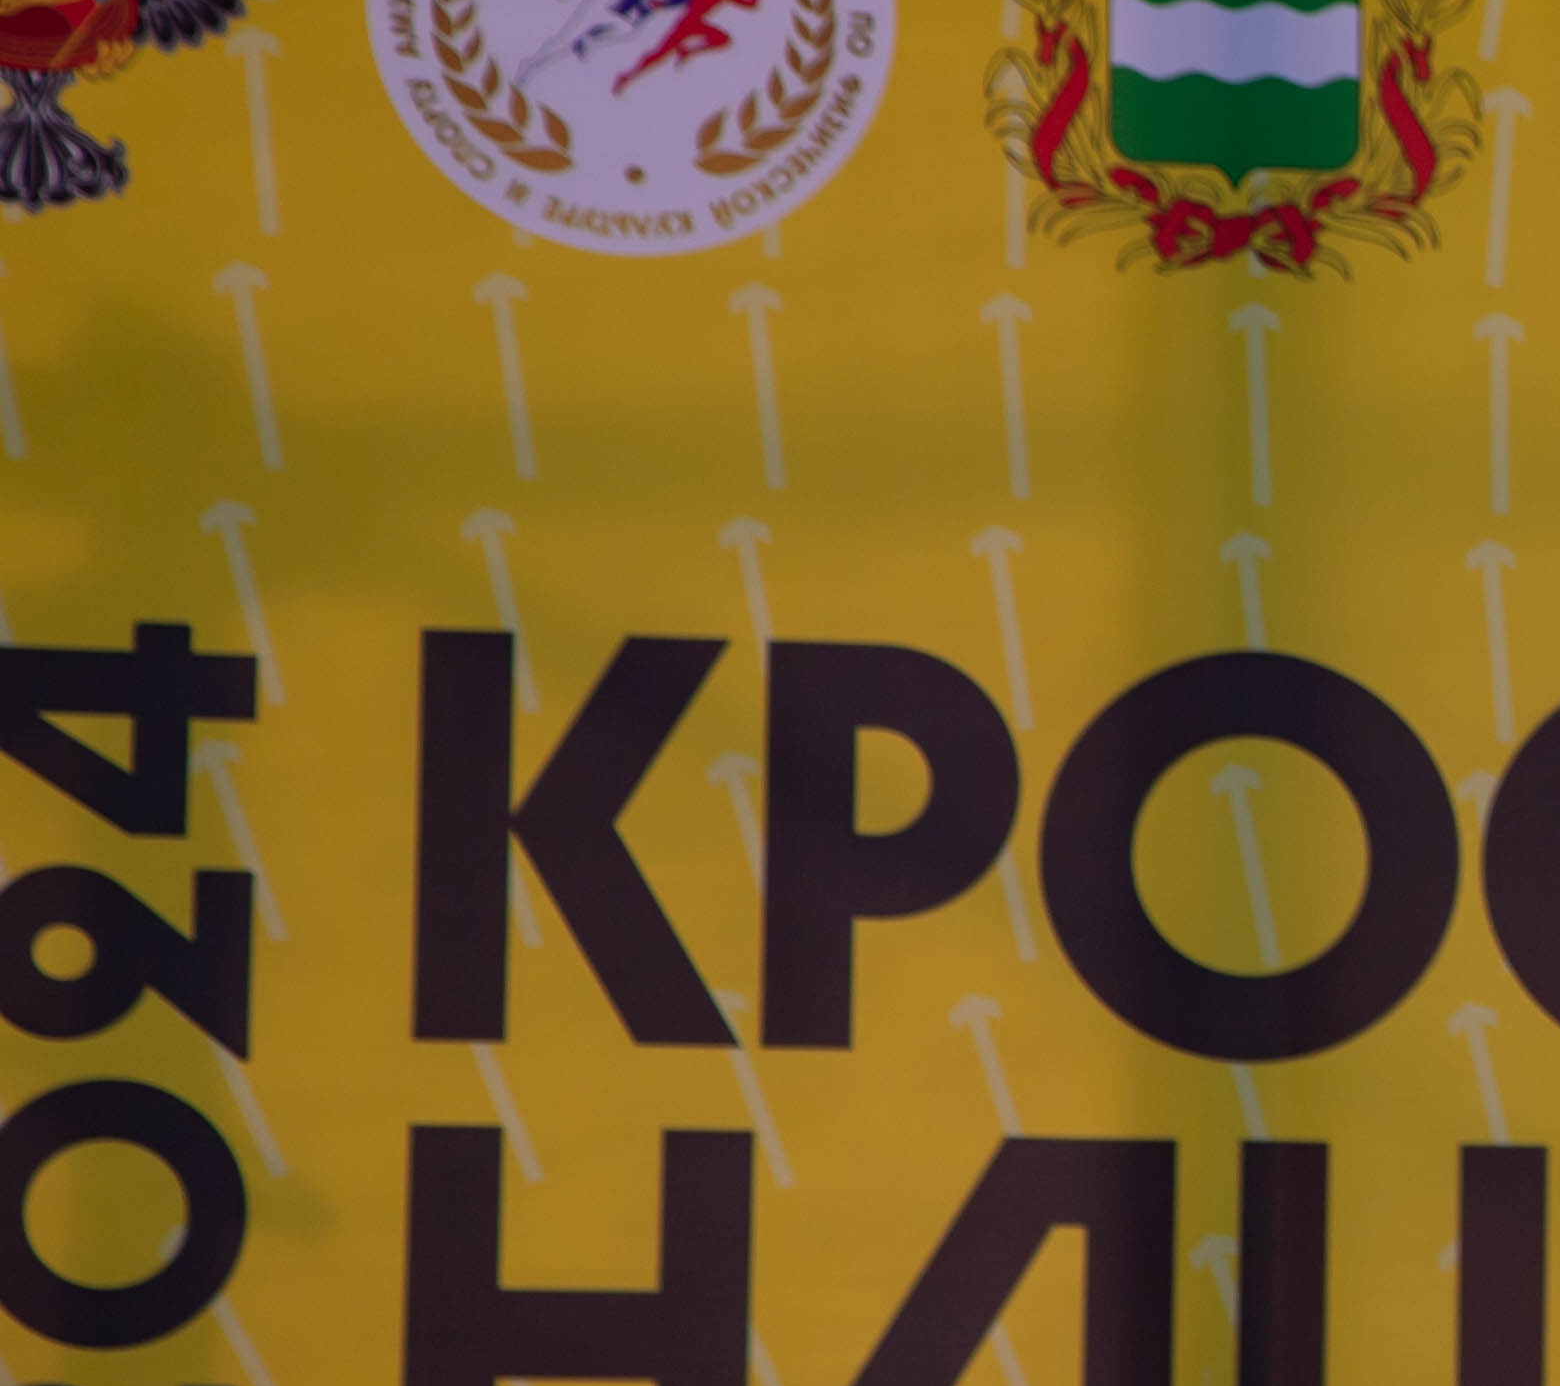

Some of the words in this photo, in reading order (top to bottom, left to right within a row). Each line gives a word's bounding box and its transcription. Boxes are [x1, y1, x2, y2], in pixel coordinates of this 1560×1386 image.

[847, 10, 874, 58] ПО
[709, 74, 863, 230] ФИЗИЧЕСКОЙ
[504, 179, 531, 205] И
